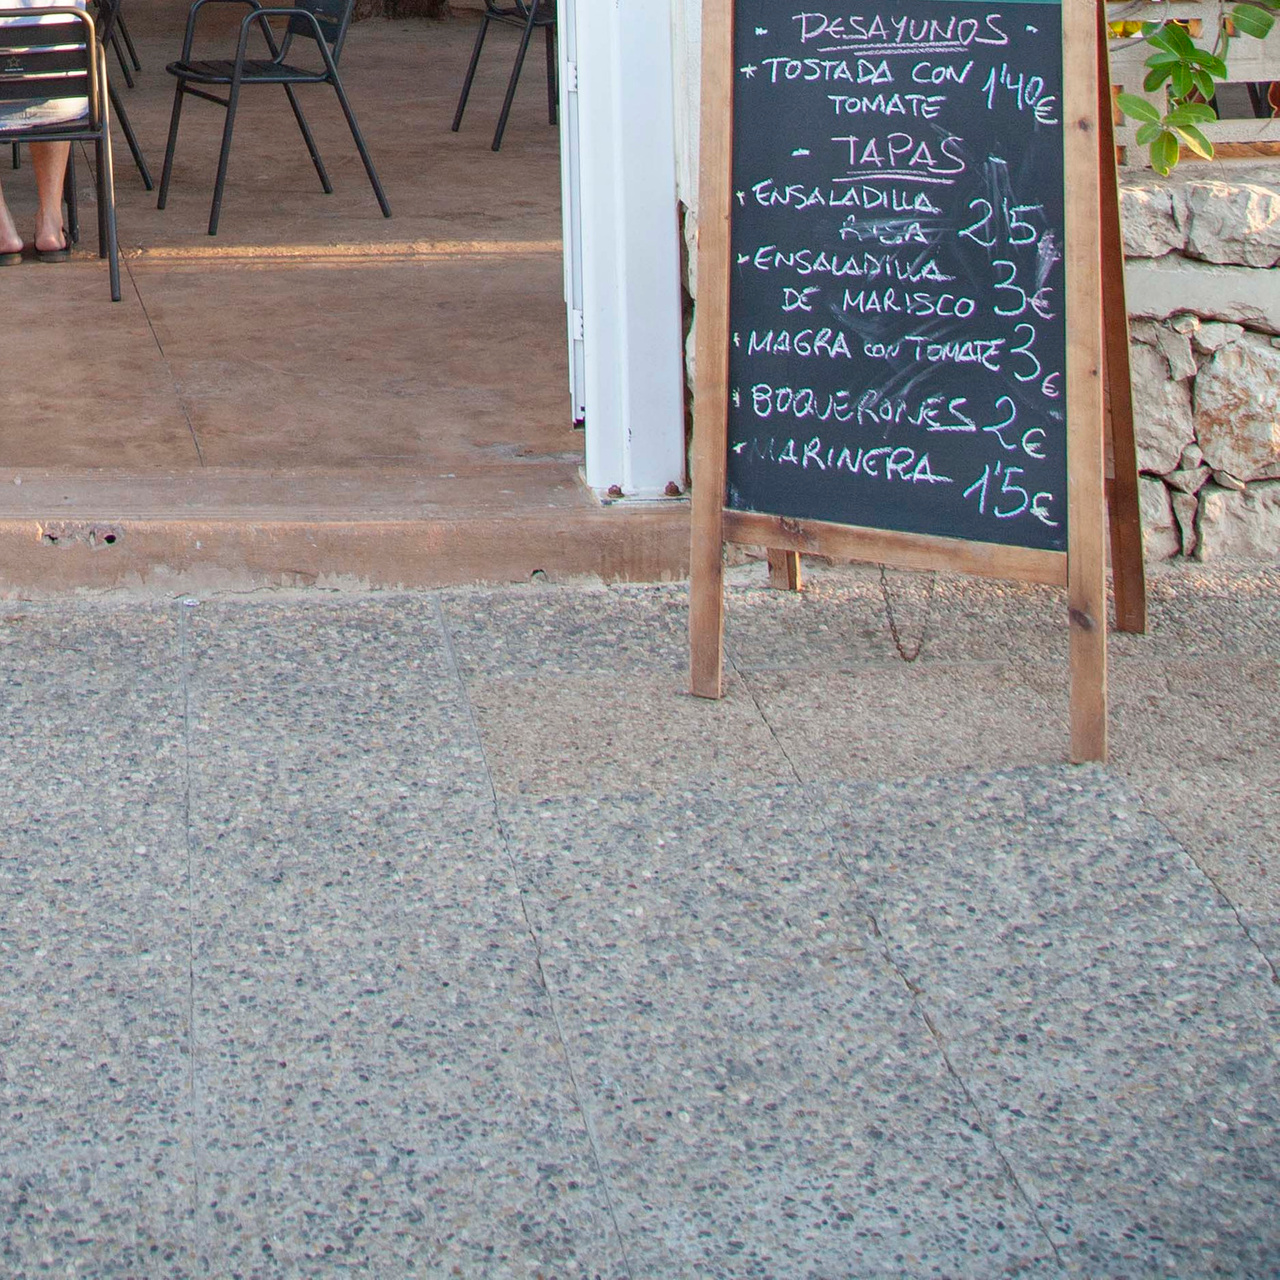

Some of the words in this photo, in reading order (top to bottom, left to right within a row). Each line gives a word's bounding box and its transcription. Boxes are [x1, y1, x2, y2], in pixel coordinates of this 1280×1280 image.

[792, 11, 1010, 46] DESAYUNOS
[762, 57, 894, 84] TOSTADA
[911, 60, 974, 85] CON
[827, 93, 948, 119] TOMATE
[830, 132, 966, 174] TAPAS
[752, 178, 944, 214] ENSALADILLA
[753, 244, 957, 283] ENSALADILLA
[781, 285, 822, 312] DE
[842, 287, 975, 318] MARISCO
[748, 327, 852, 359] MAGRA
[905, 334, 1006, 371] TOMATE
[751, 382, 977, 432] BOQUERONES
[750, 435, 954, 484] MARINERA
